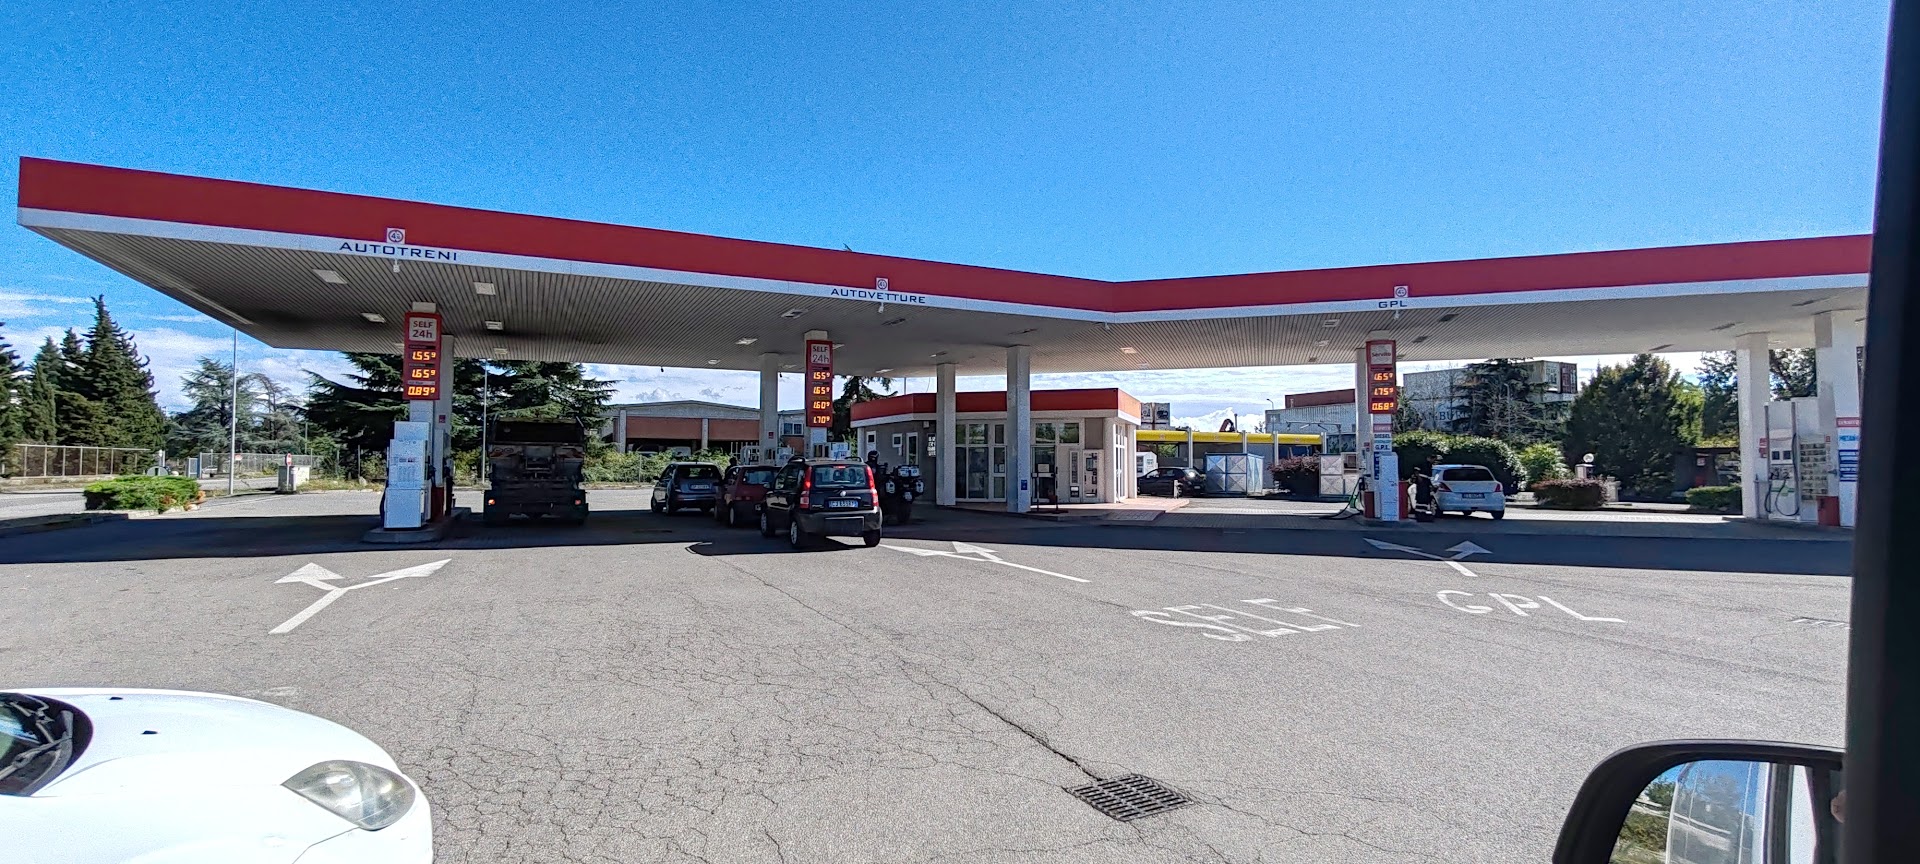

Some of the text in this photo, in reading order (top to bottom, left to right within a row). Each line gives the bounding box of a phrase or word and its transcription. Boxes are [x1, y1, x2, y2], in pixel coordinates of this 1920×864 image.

[339, 242, 458, 261] AUTOTRENI
[830, 288, 926, 304] AUTOVETTURE
[1378, 300, 1407, 309] GPL
[413, 320, 433, 328] SELF
[412, 329, 433, 338] 24h
[812, 345, 828, 353] SELF
[812, 354, 829, 363] 24h
[1436, 589, 1626, 617] GPL
[1130, 598, 1362, 642] SELF
